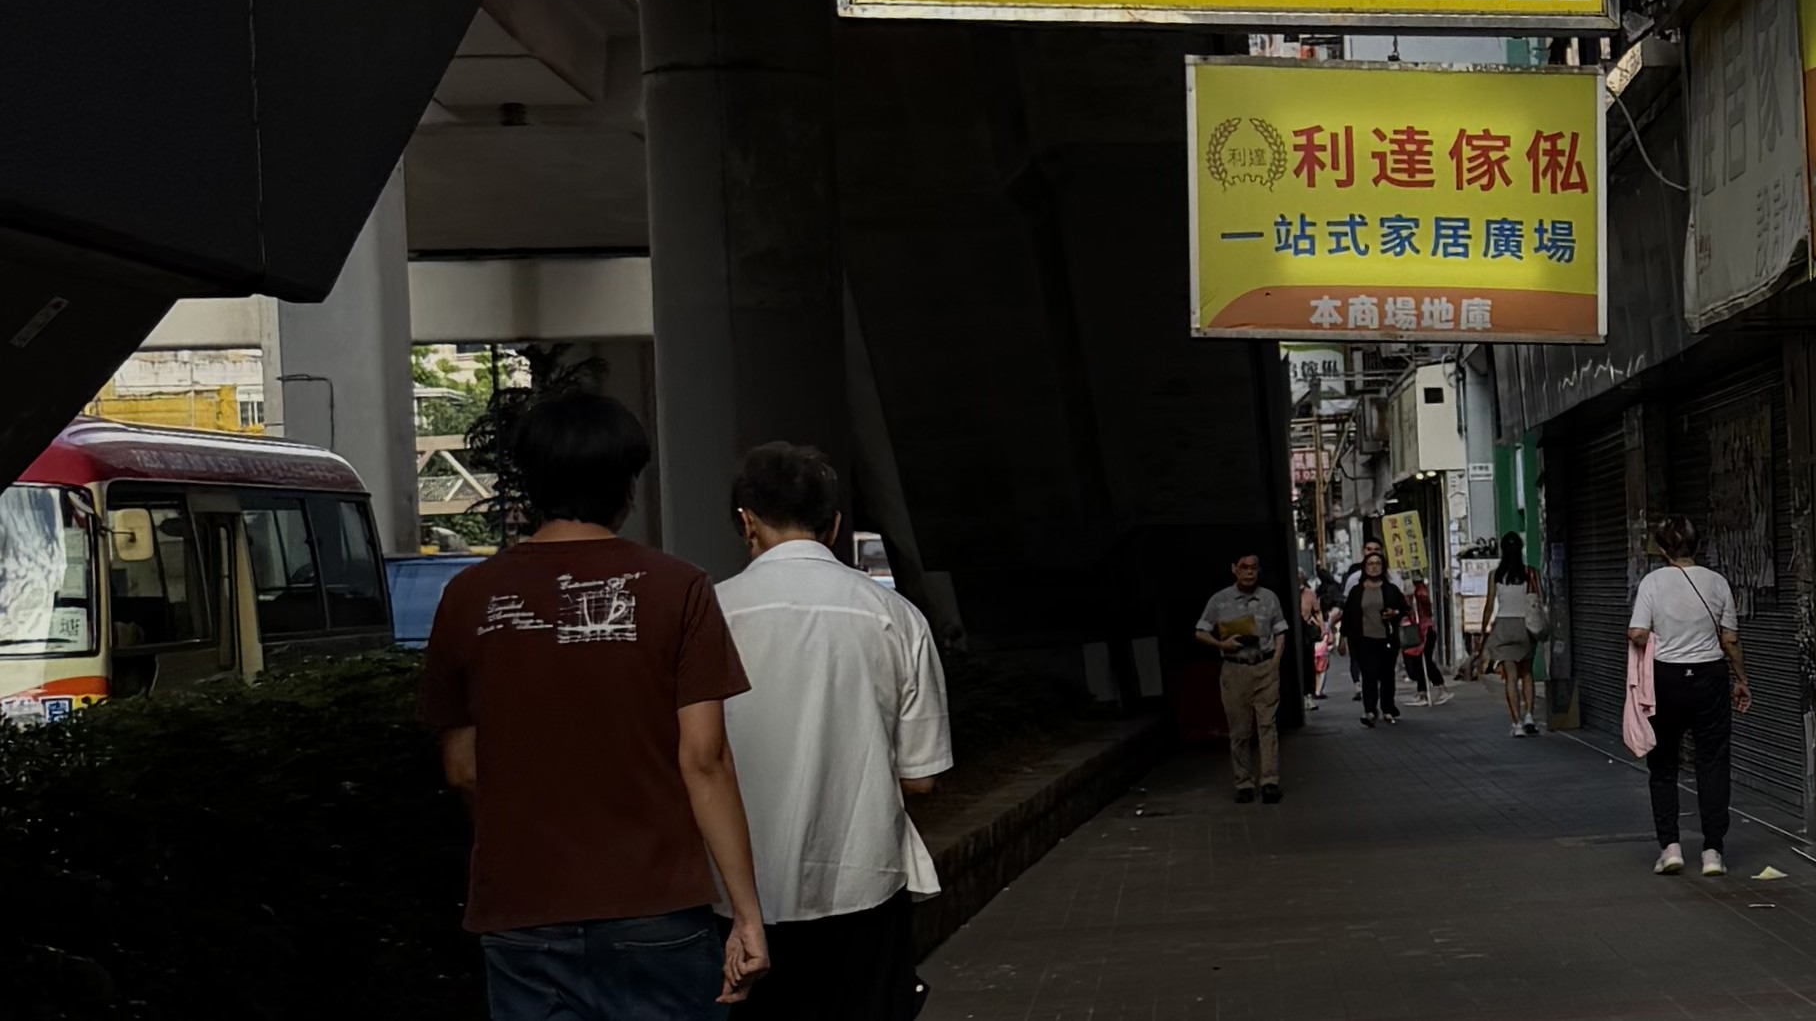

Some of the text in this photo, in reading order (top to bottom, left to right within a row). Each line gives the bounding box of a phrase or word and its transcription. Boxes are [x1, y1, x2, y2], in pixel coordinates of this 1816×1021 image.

[1292, 124, 1590, 195] 利達傢俬
[1220, 212, 1578, 264] 一站式家居廣場
[1309, 295, 1493, 331] 本商場地庫
